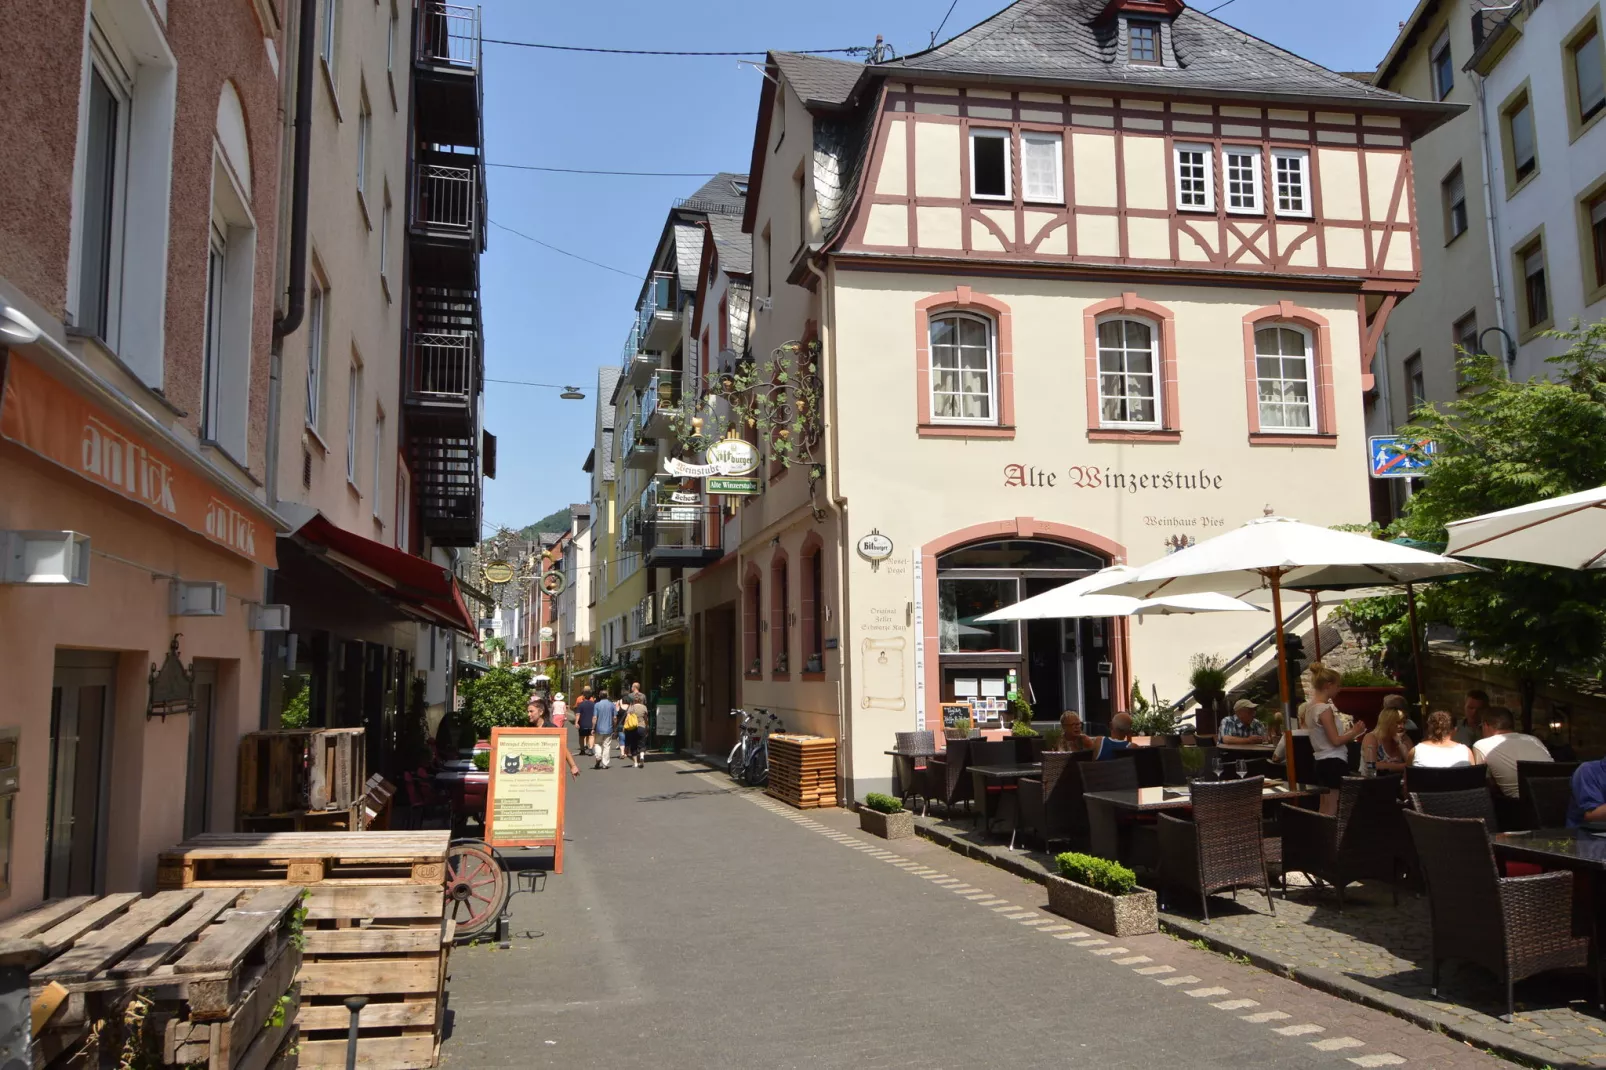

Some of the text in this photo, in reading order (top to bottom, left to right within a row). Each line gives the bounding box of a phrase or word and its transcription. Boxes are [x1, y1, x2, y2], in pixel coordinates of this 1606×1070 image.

[676, 461, 720, 476] Weinstube
[711, 480, 721, 488] Alte
[1003, 463, 1223, 494] Alte Winzerstube
[1143, 515, 1225, 527] Weinhaus Pies
[864, 541, 888, 551] Bitburger
